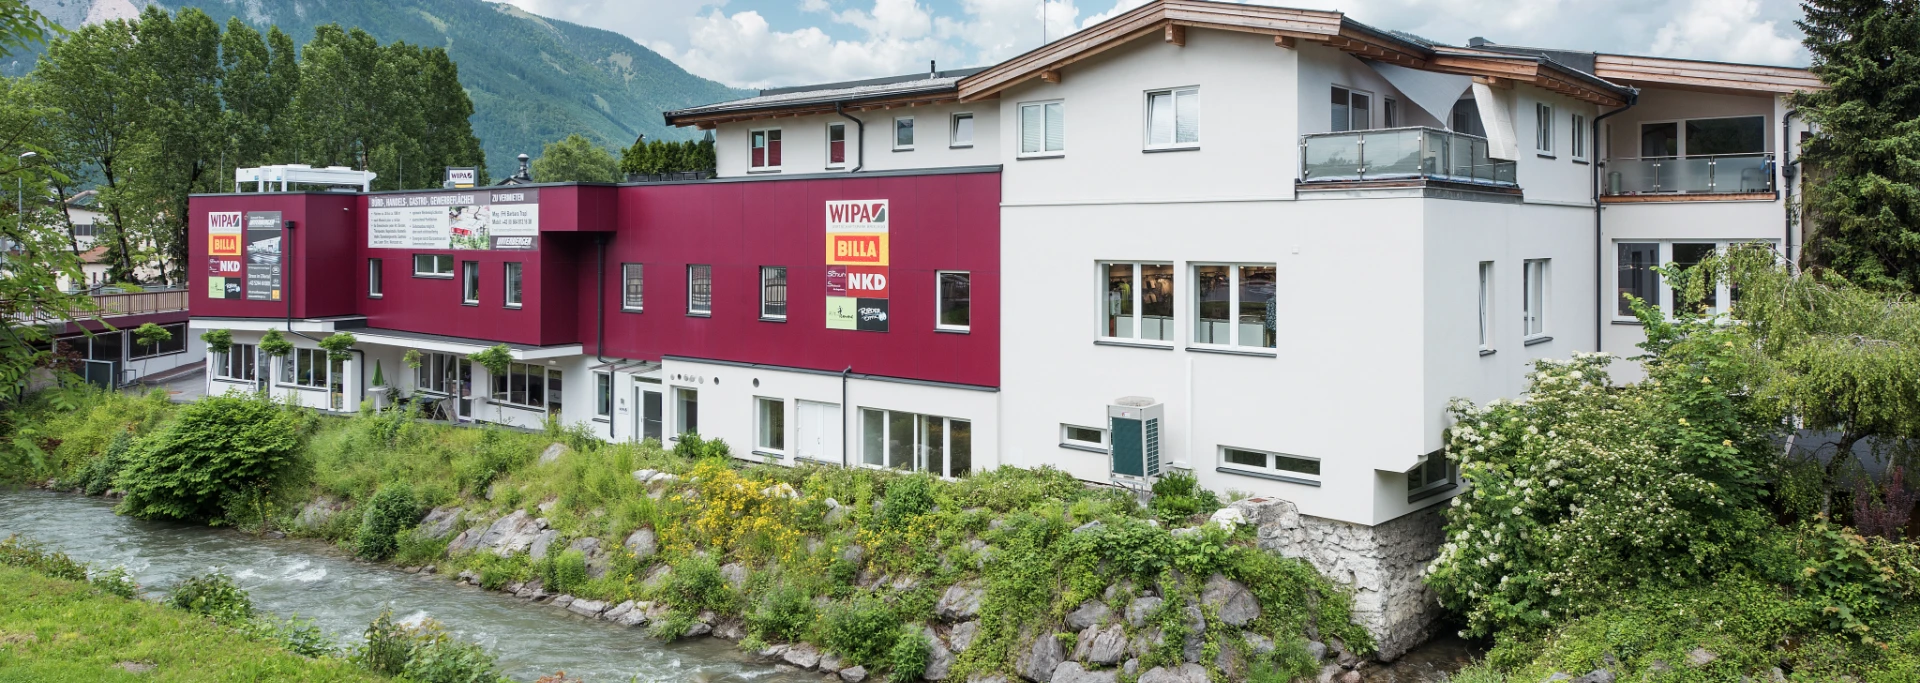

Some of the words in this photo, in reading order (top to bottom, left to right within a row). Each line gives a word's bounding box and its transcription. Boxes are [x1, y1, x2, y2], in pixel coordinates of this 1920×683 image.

[211, 214, 233, 227] WIPA
[829, 203, 871, 223] WIPA
[214, 239, 235, 250] BILLA
[837, 240, 877, 257] BILLA
[220, 260, 240, 272] NKD
[848, 272, 886, 290] NKD
